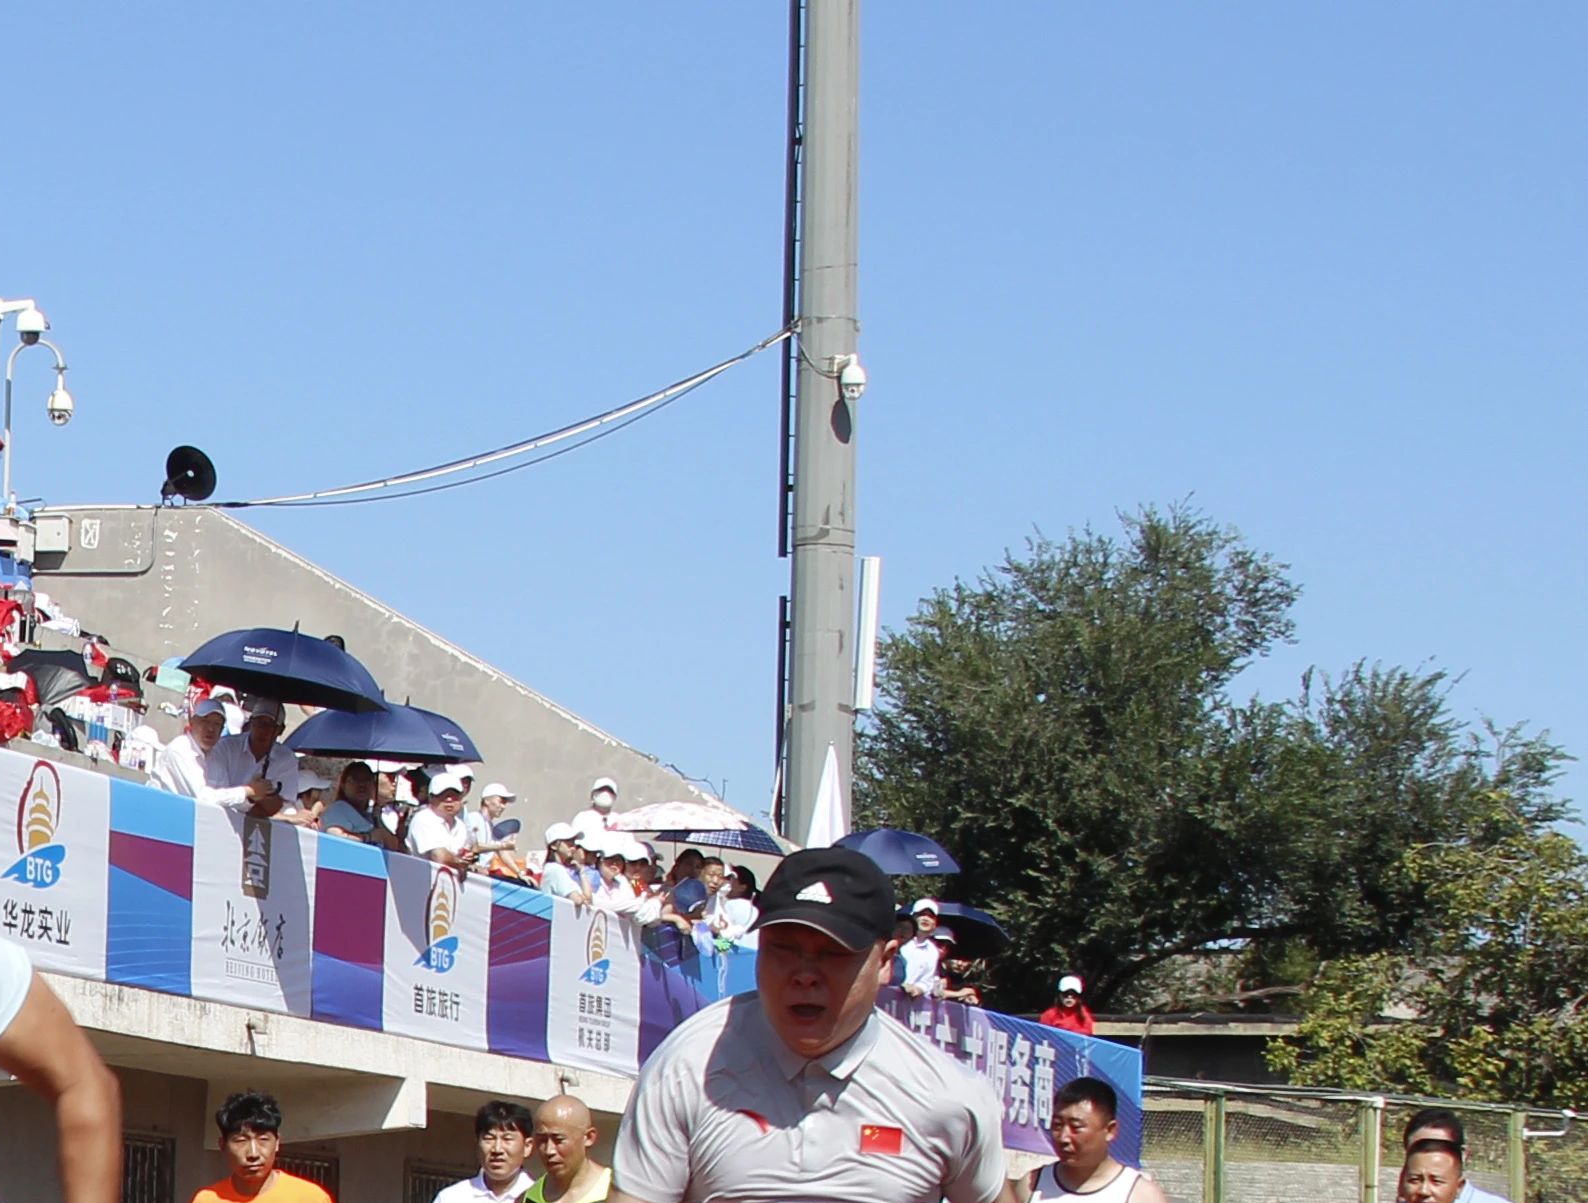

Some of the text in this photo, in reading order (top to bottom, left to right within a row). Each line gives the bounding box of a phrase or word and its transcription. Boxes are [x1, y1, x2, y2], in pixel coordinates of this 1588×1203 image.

[26, 856, 52, 883] BTG
[3, 899, 71, 945] 华龙实业
[430, 947, 450, 968] BTG
